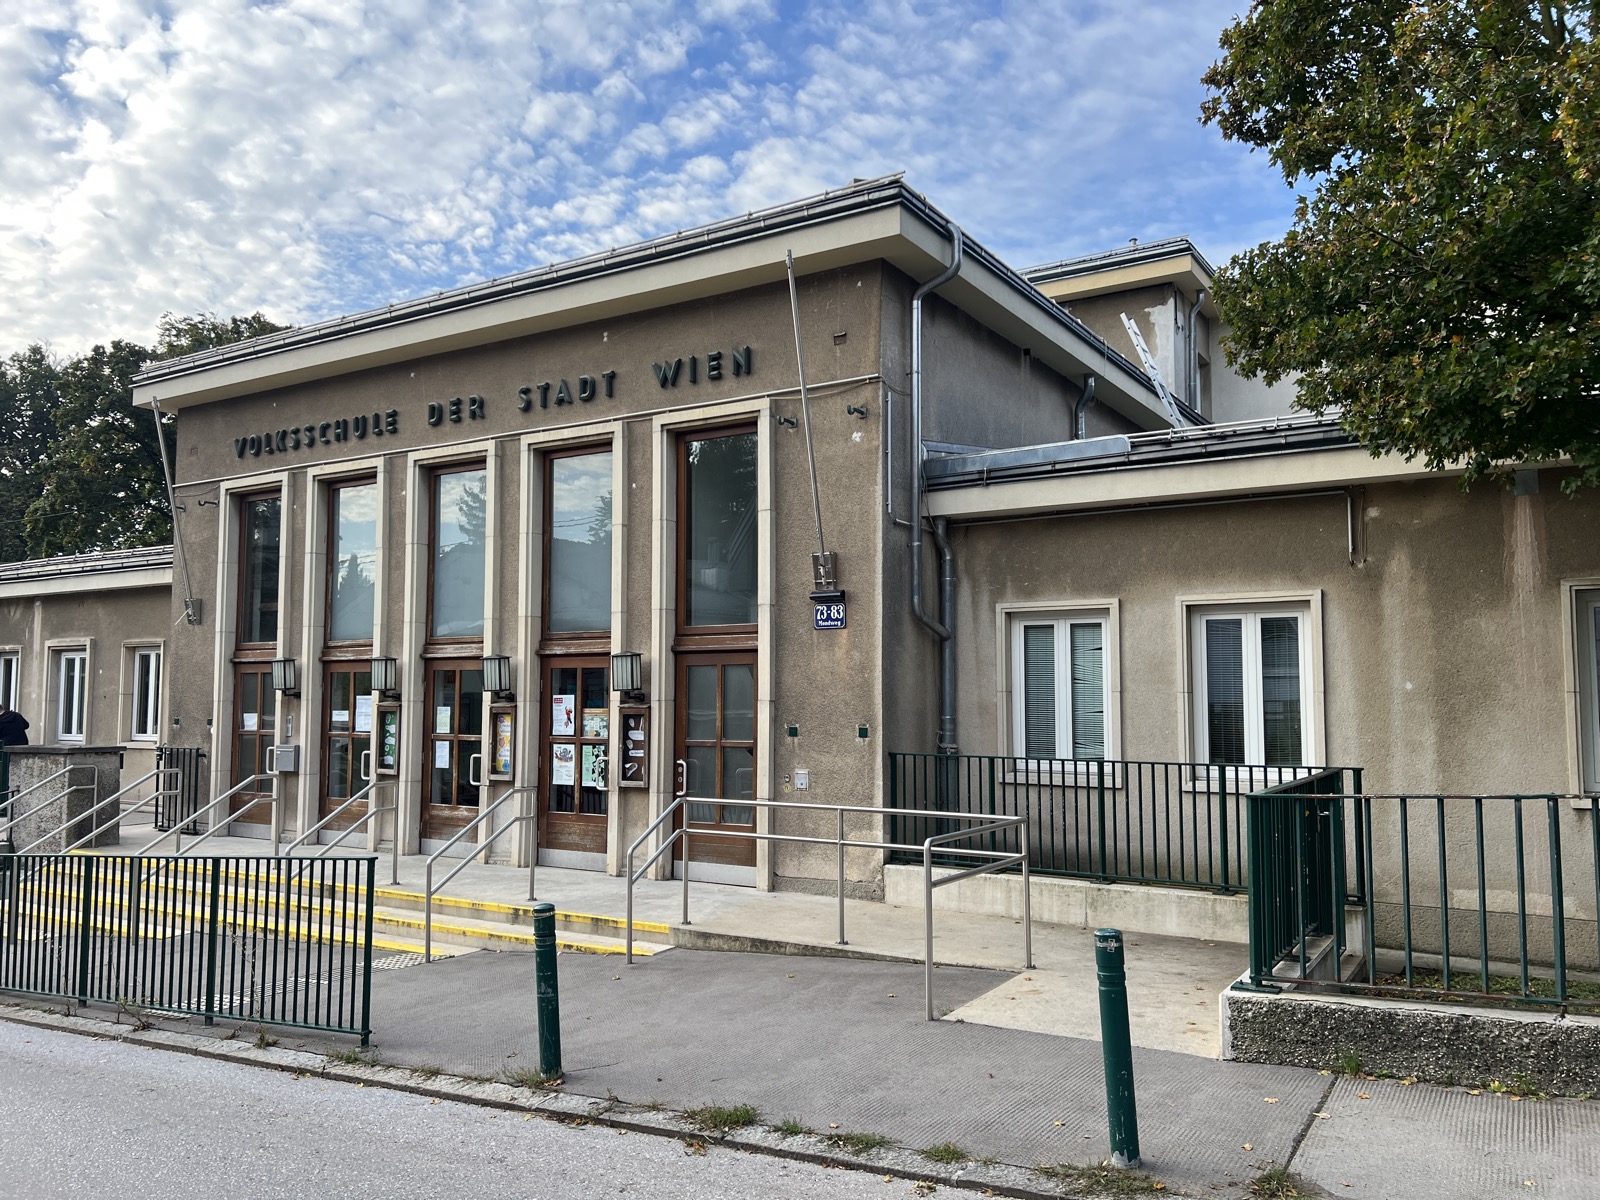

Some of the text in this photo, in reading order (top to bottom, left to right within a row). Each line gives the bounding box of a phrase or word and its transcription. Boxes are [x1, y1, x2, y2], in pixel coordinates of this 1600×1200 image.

[234, 345, 751, 458] VOLKSSCHULE DER STADT WIEN
[816, 605, 843, 619] 73-83
